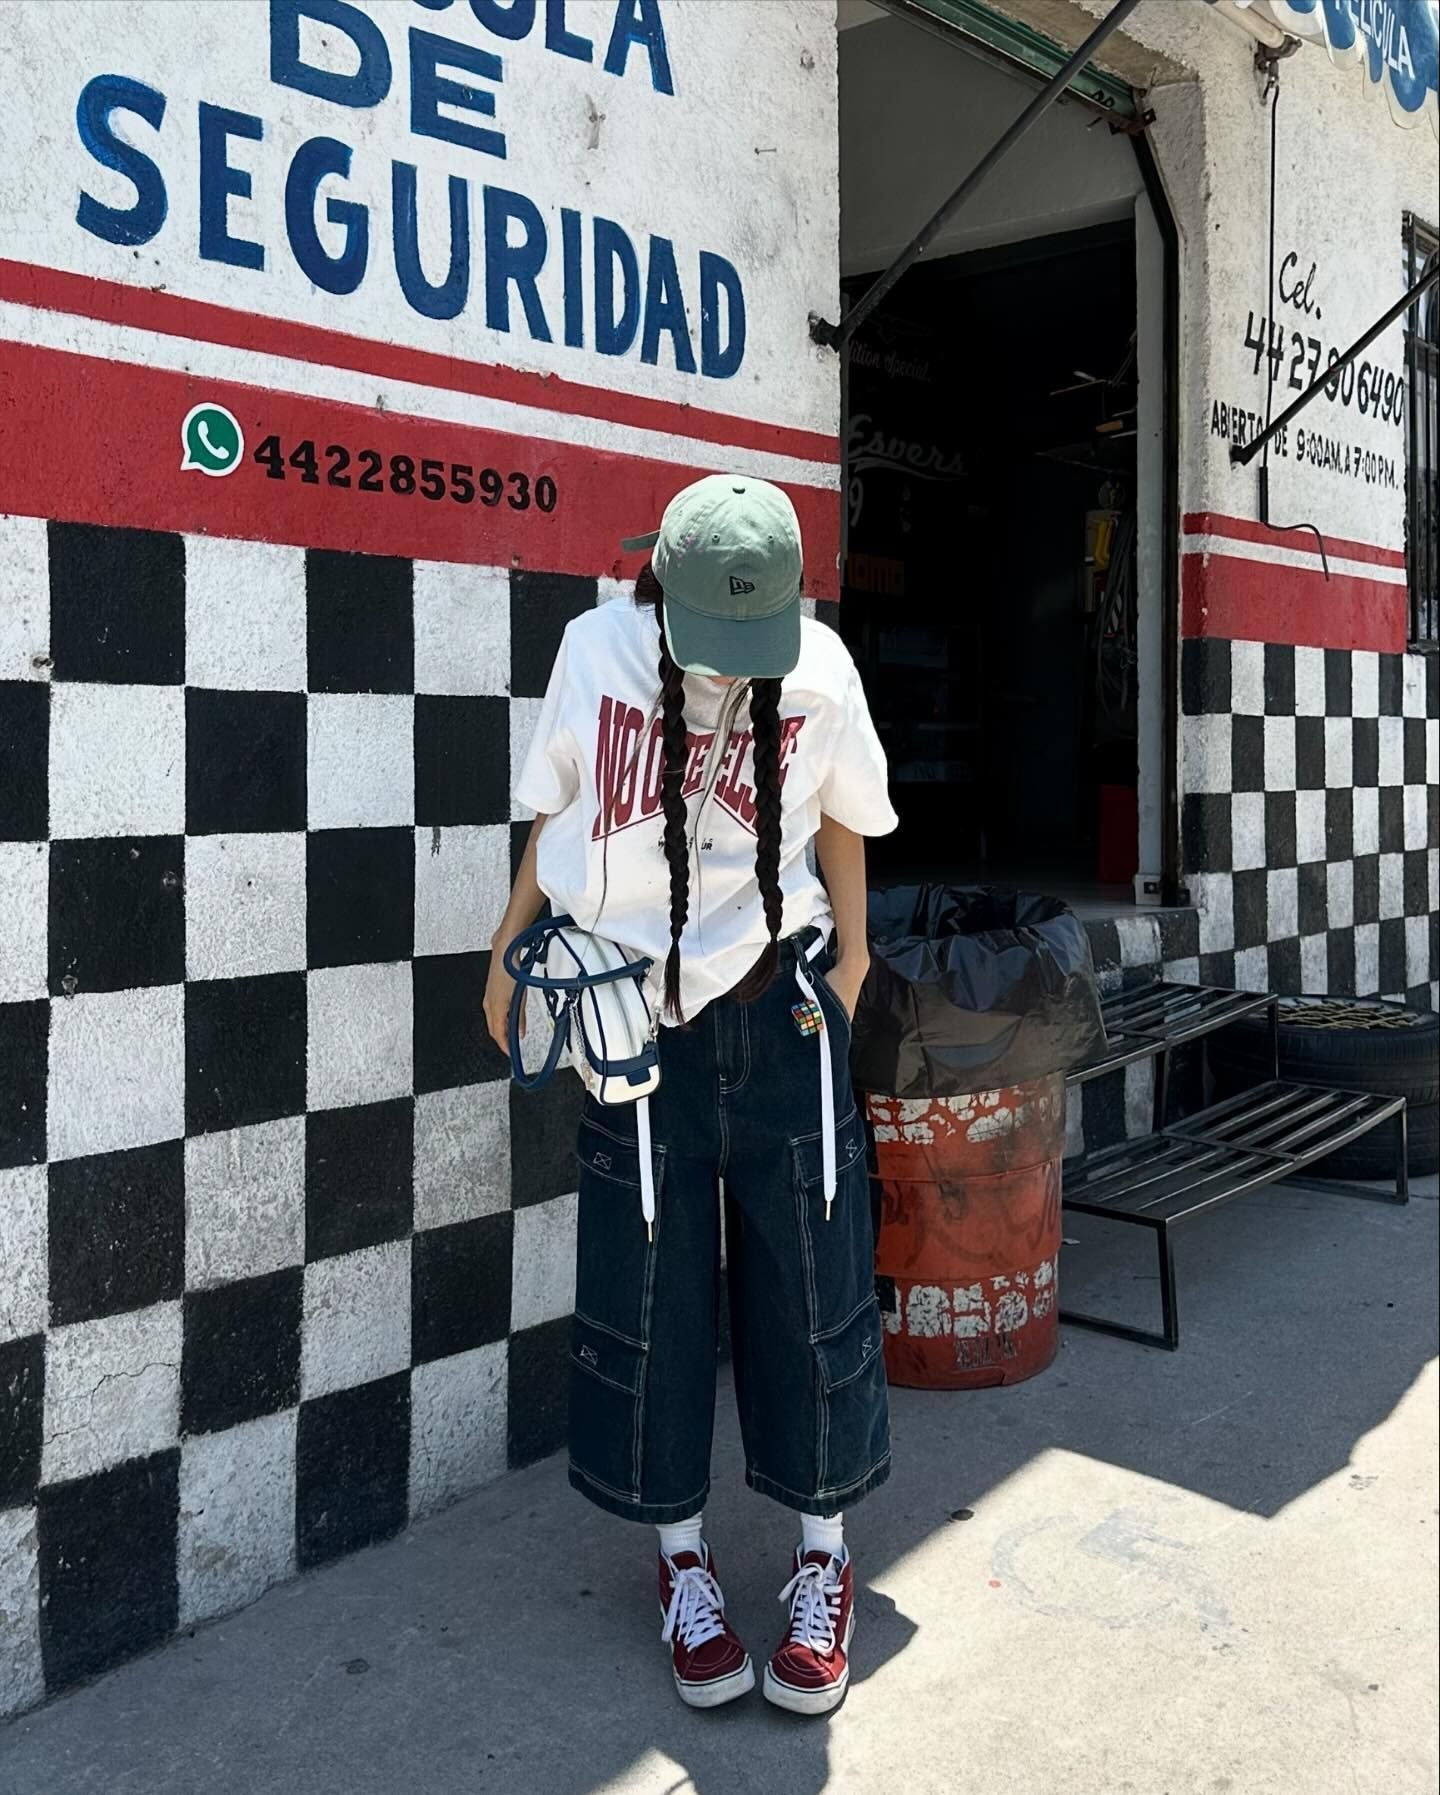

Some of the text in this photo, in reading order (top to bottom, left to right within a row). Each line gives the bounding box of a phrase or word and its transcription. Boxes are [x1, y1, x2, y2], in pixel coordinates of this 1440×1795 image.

[269, 0, 507, 160] DE
[76, 74, 746, 380] SEGURIDAD
[1279, 252, 1321, 320] Cel.
[1210, 399, 1264, 447] ABIERTO
[1273, 424, 1288, 458] DE
[253, 435, 558, 513] 4422855930
